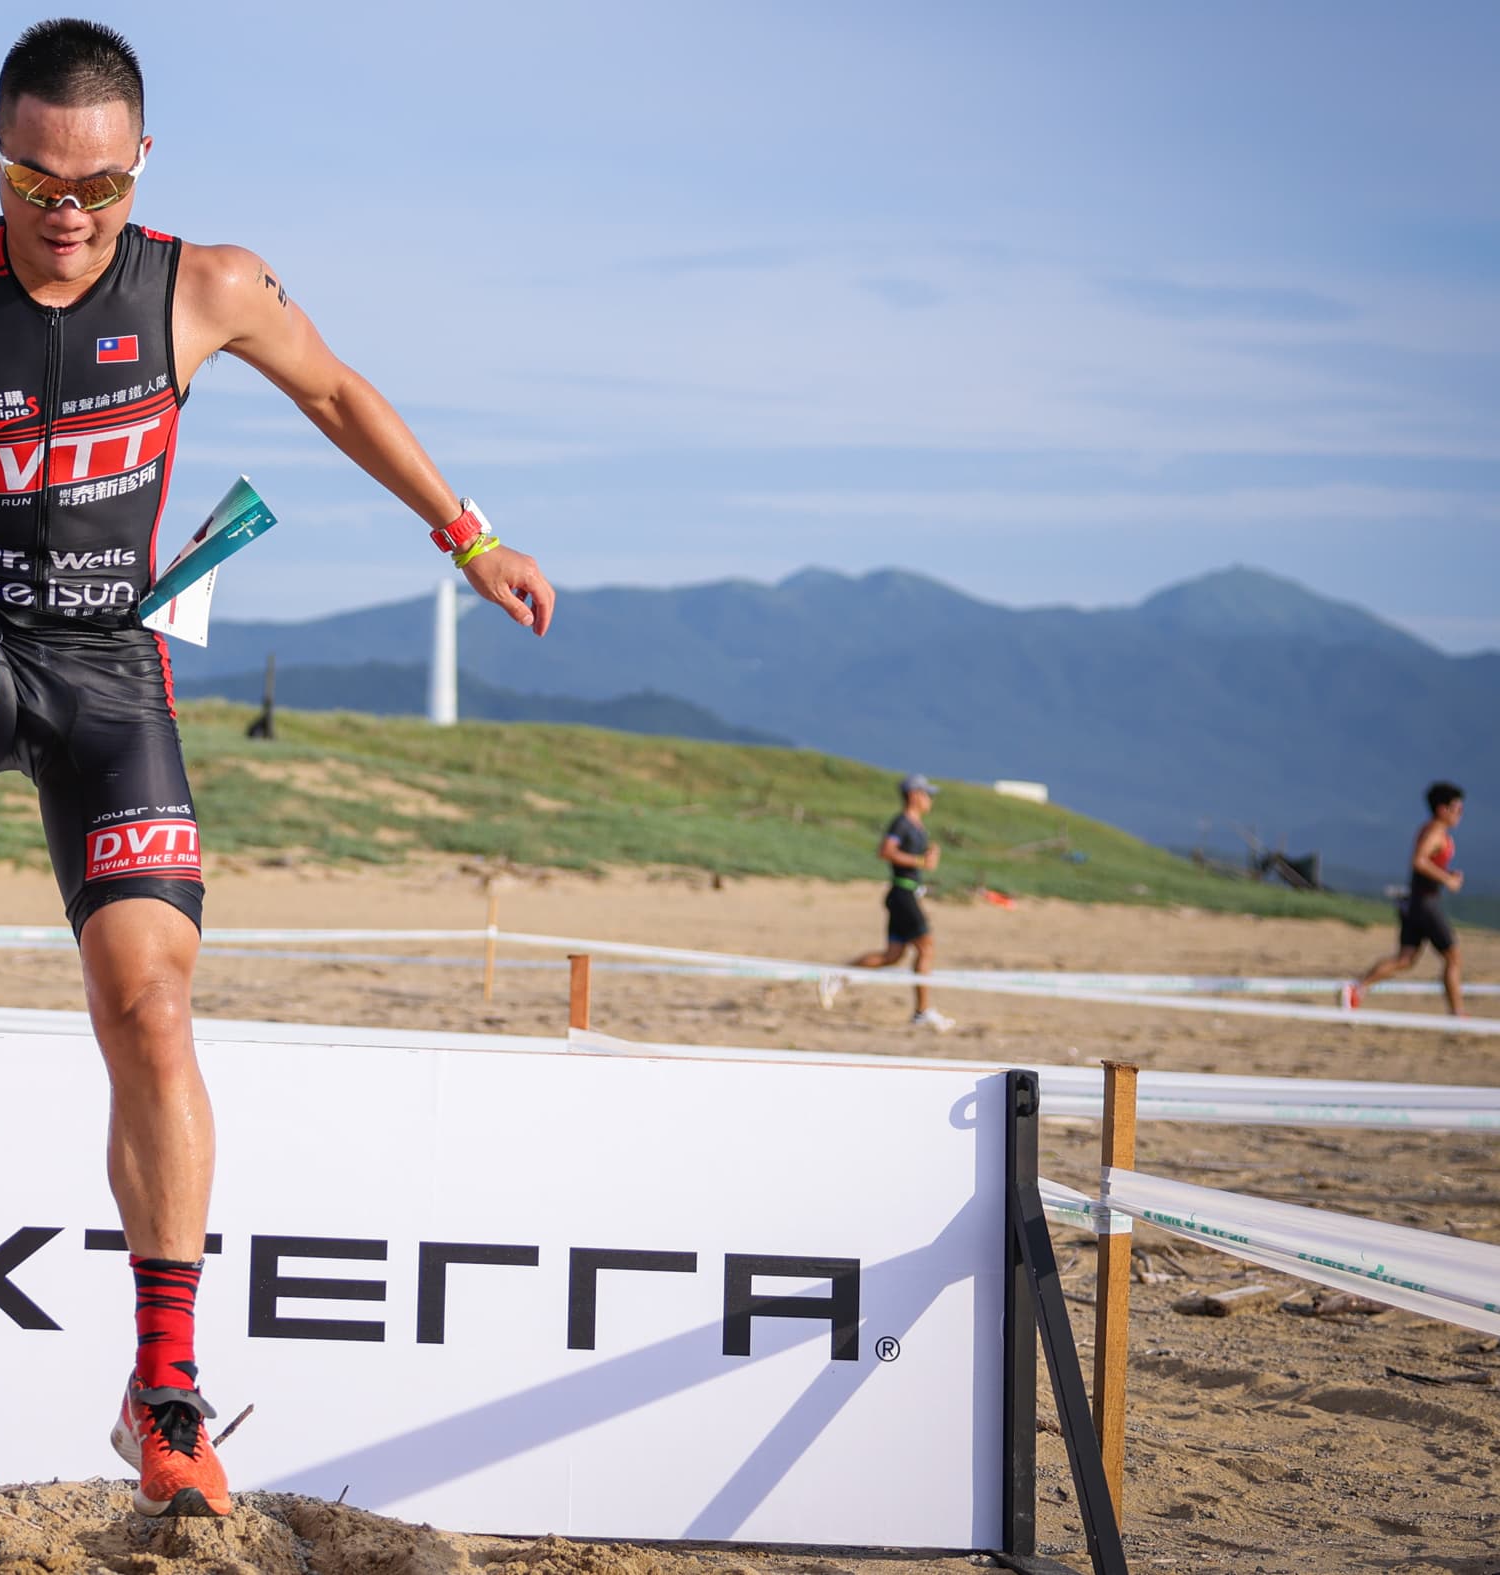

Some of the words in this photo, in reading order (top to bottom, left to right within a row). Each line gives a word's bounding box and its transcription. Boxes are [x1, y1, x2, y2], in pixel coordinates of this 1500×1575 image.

[48, 548, 137, 570] Wells
[93, 824, 198, 862] DVTT
[92, 858, 130, 873] SWIM
[136, 854, 173, 865] BIKE
[177, 854, 198, 863] RUN
